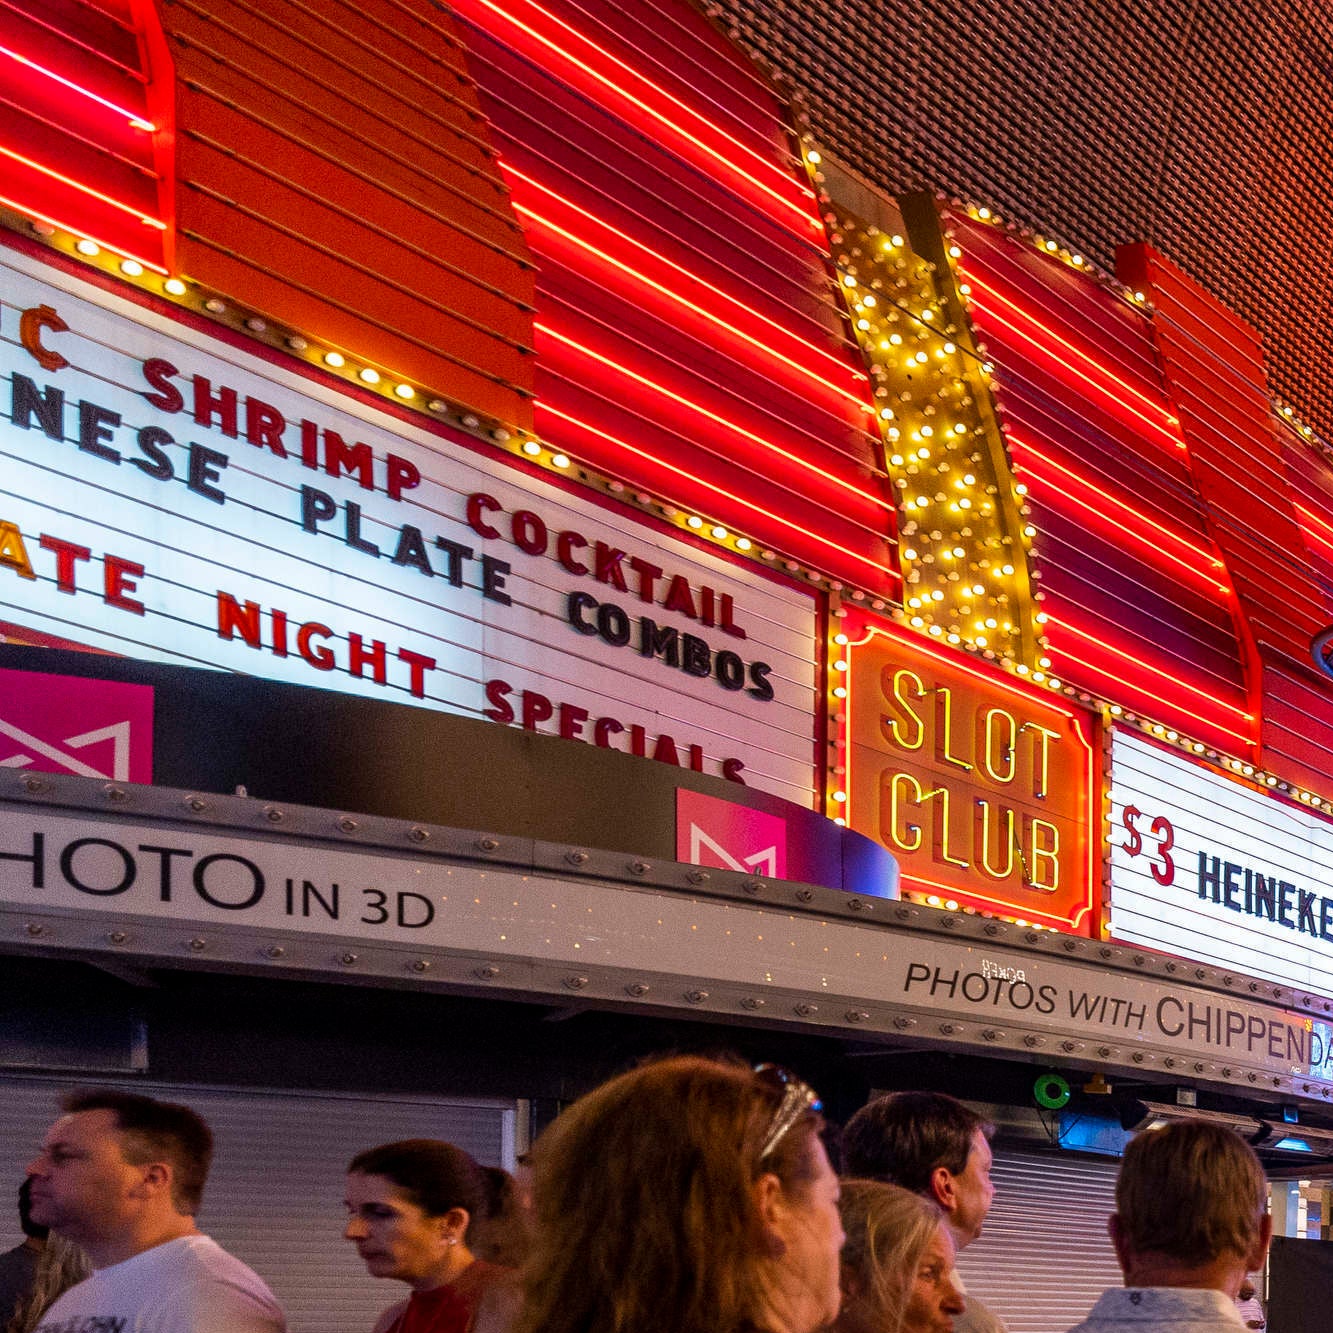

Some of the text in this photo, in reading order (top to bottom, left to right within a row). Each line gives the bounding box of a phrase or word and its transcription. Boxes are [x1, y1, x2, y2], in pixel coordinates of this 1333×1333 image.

[11, 371, 775, 702] NESE PLATE COMBOS
[138, 356, 421, 503] SHRIMP
[465, 491, 747, 640] COCKTAIL
[0, 517, 747, 786] ATE NIGHT SPECIALS
[881, 664, 1063, 800] SLOT
[0, 832, 435, 929] HOTO IN 3D
[880, 771, 1062, 893] CLUB
[1122, 804, 1175, 887] $3
[904, 961, 1057, 1015] PHOTOS
[1068, 988, 1146, 1031] WITH
